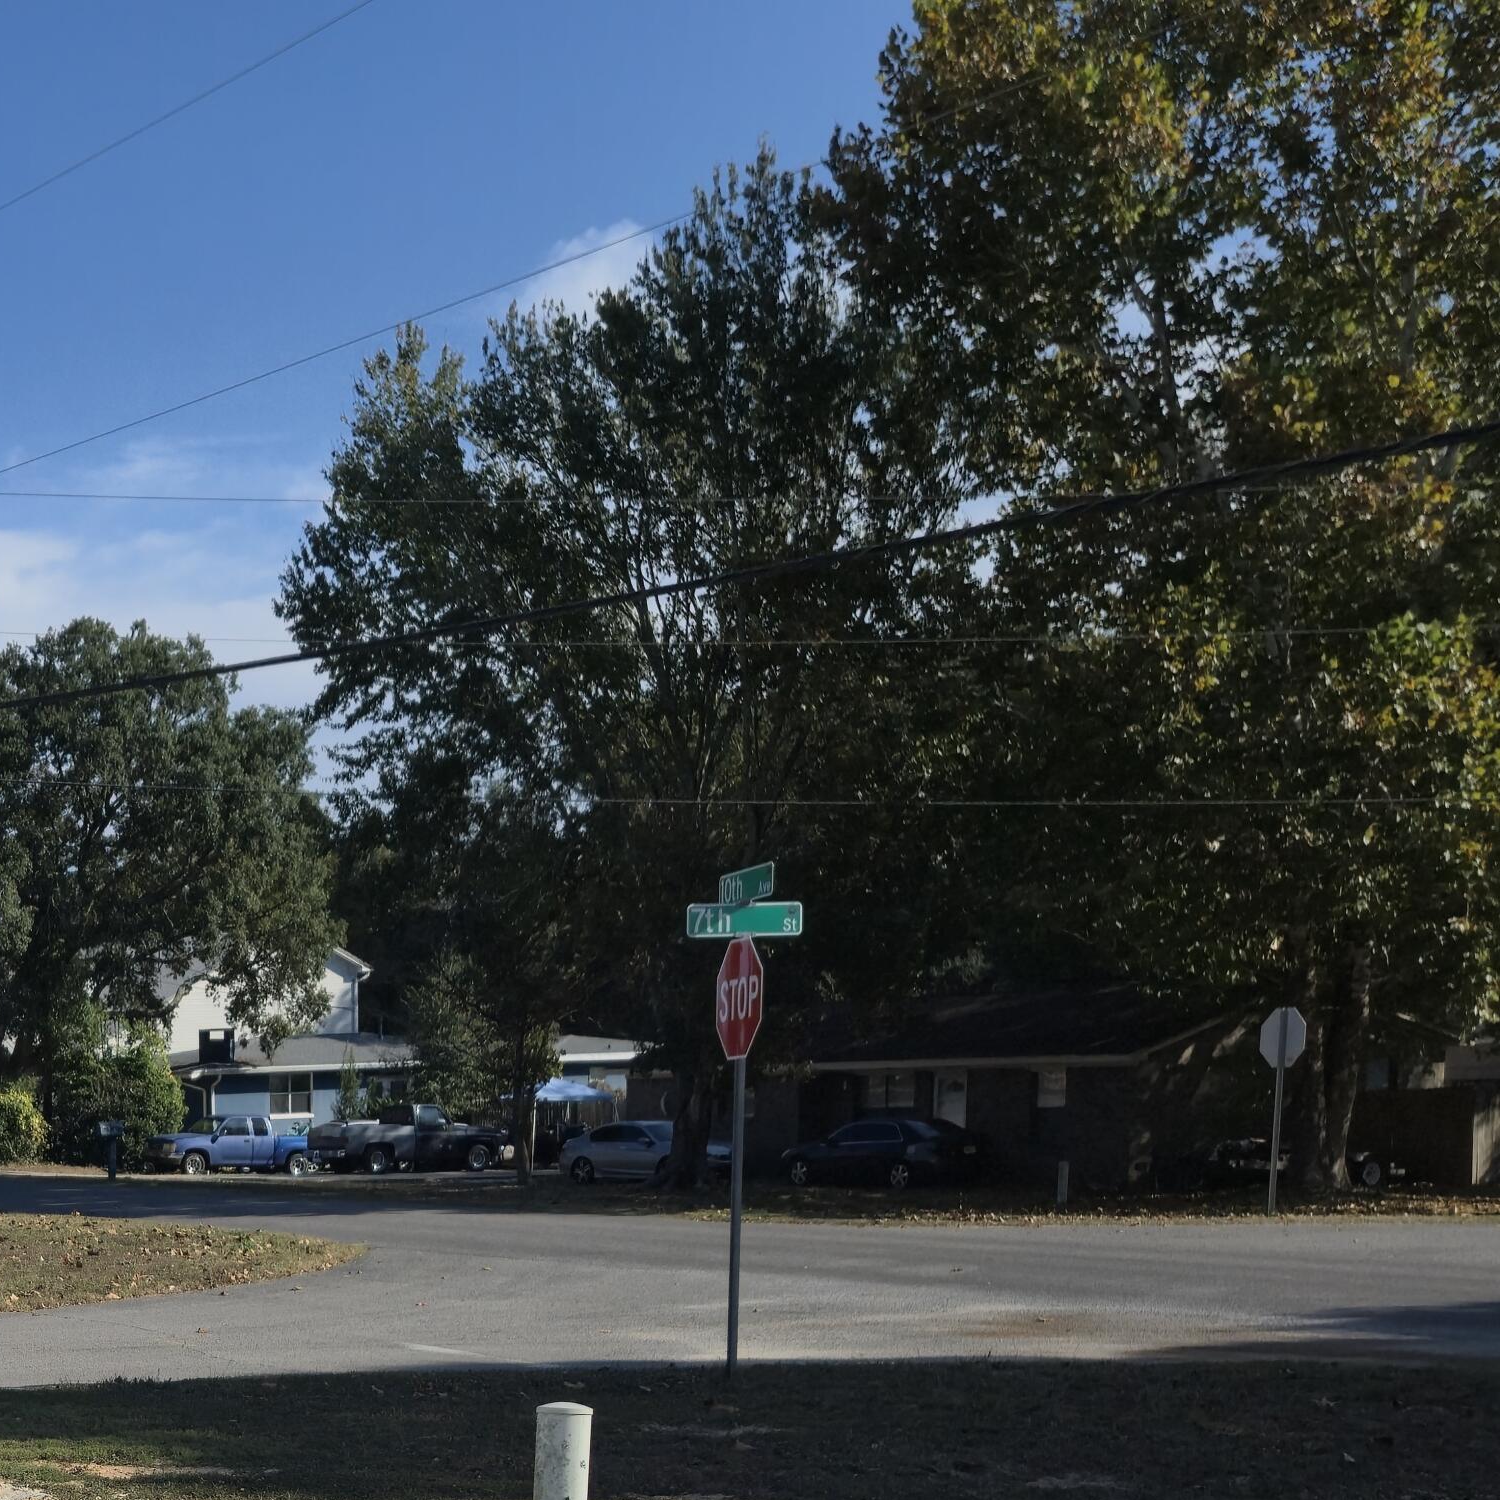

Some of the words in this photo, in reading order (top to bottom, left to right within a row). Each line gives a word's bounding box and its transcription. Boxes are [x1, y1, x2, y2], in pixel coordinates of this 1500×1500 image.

[721, 875, 743, 904] 10th
[690, 907, 731, 933] 7th
[783, 918, 797, 932] St
[720, 975, 759, 1023] STOP
